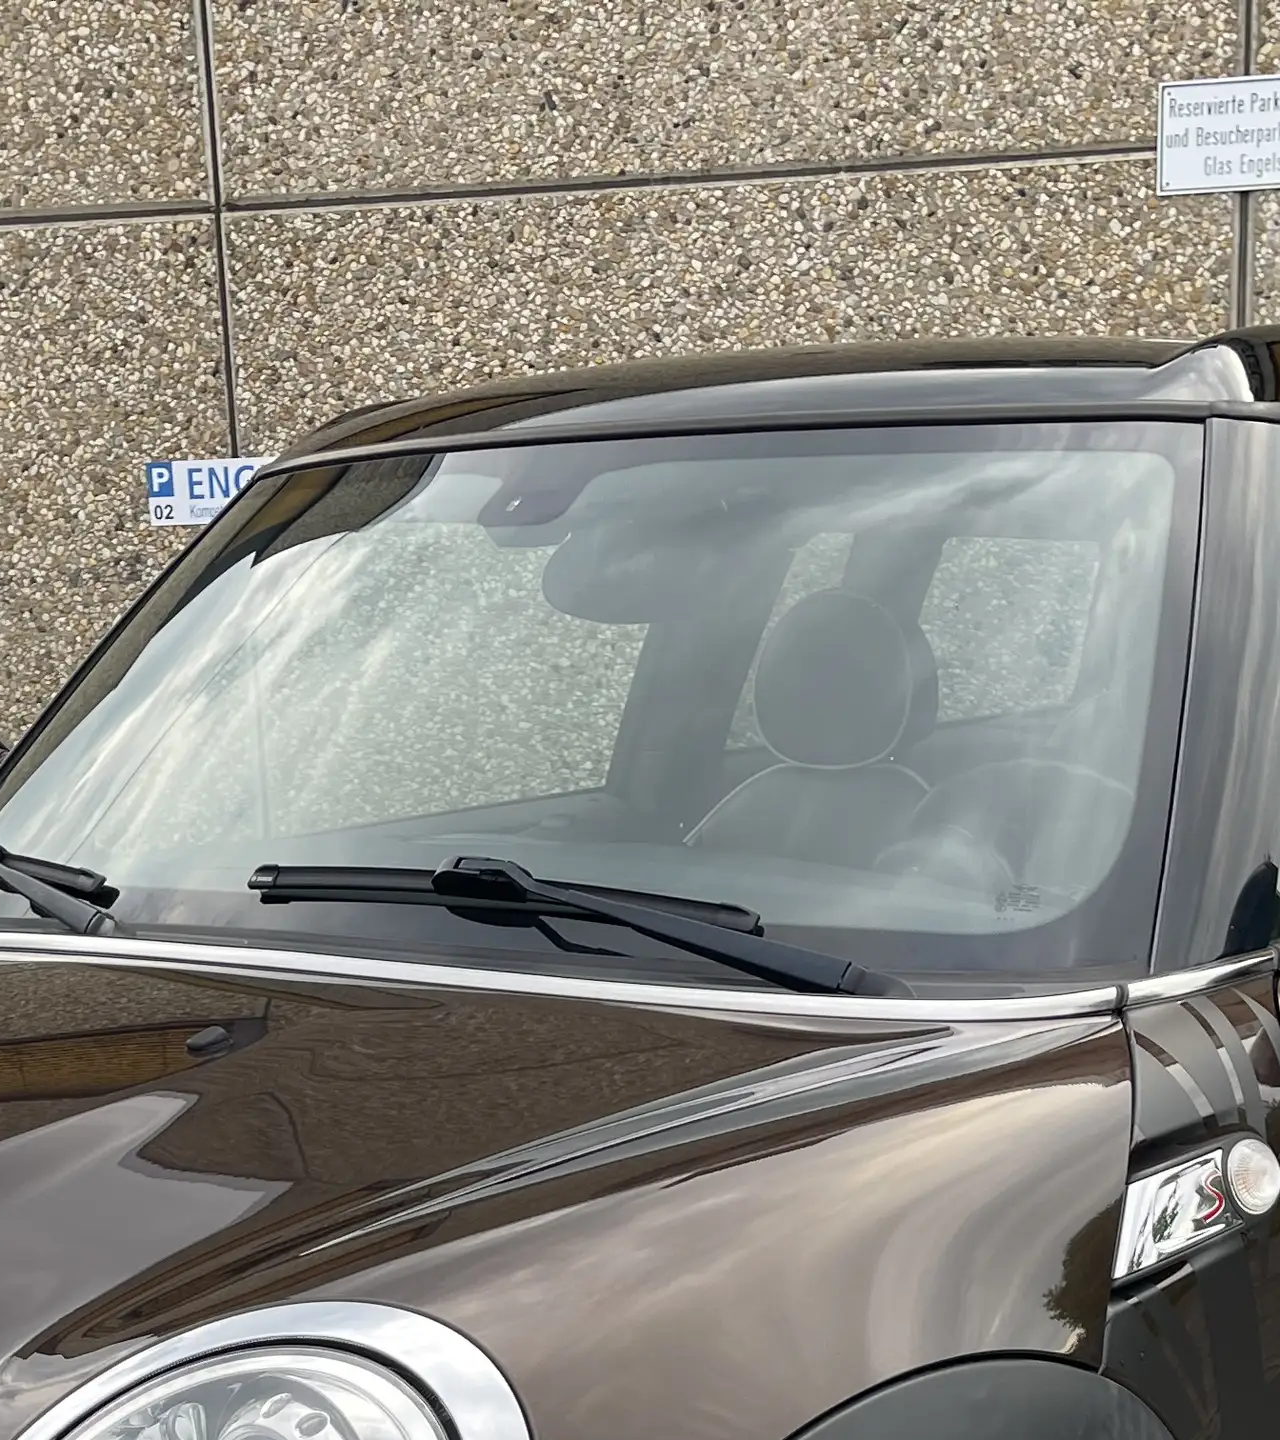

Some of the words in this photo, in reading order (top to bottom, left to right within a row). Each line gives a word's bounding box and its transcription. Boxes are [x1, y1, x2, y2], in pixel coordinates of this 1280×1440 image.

[1168, 95, 1245, 119] Reservierte
[1165, 127, 1189, 149] und
[1203, 155, 1233, 176] Glas
[150, 467, 170, 493] P
[154, 504, 174, 520] 02
